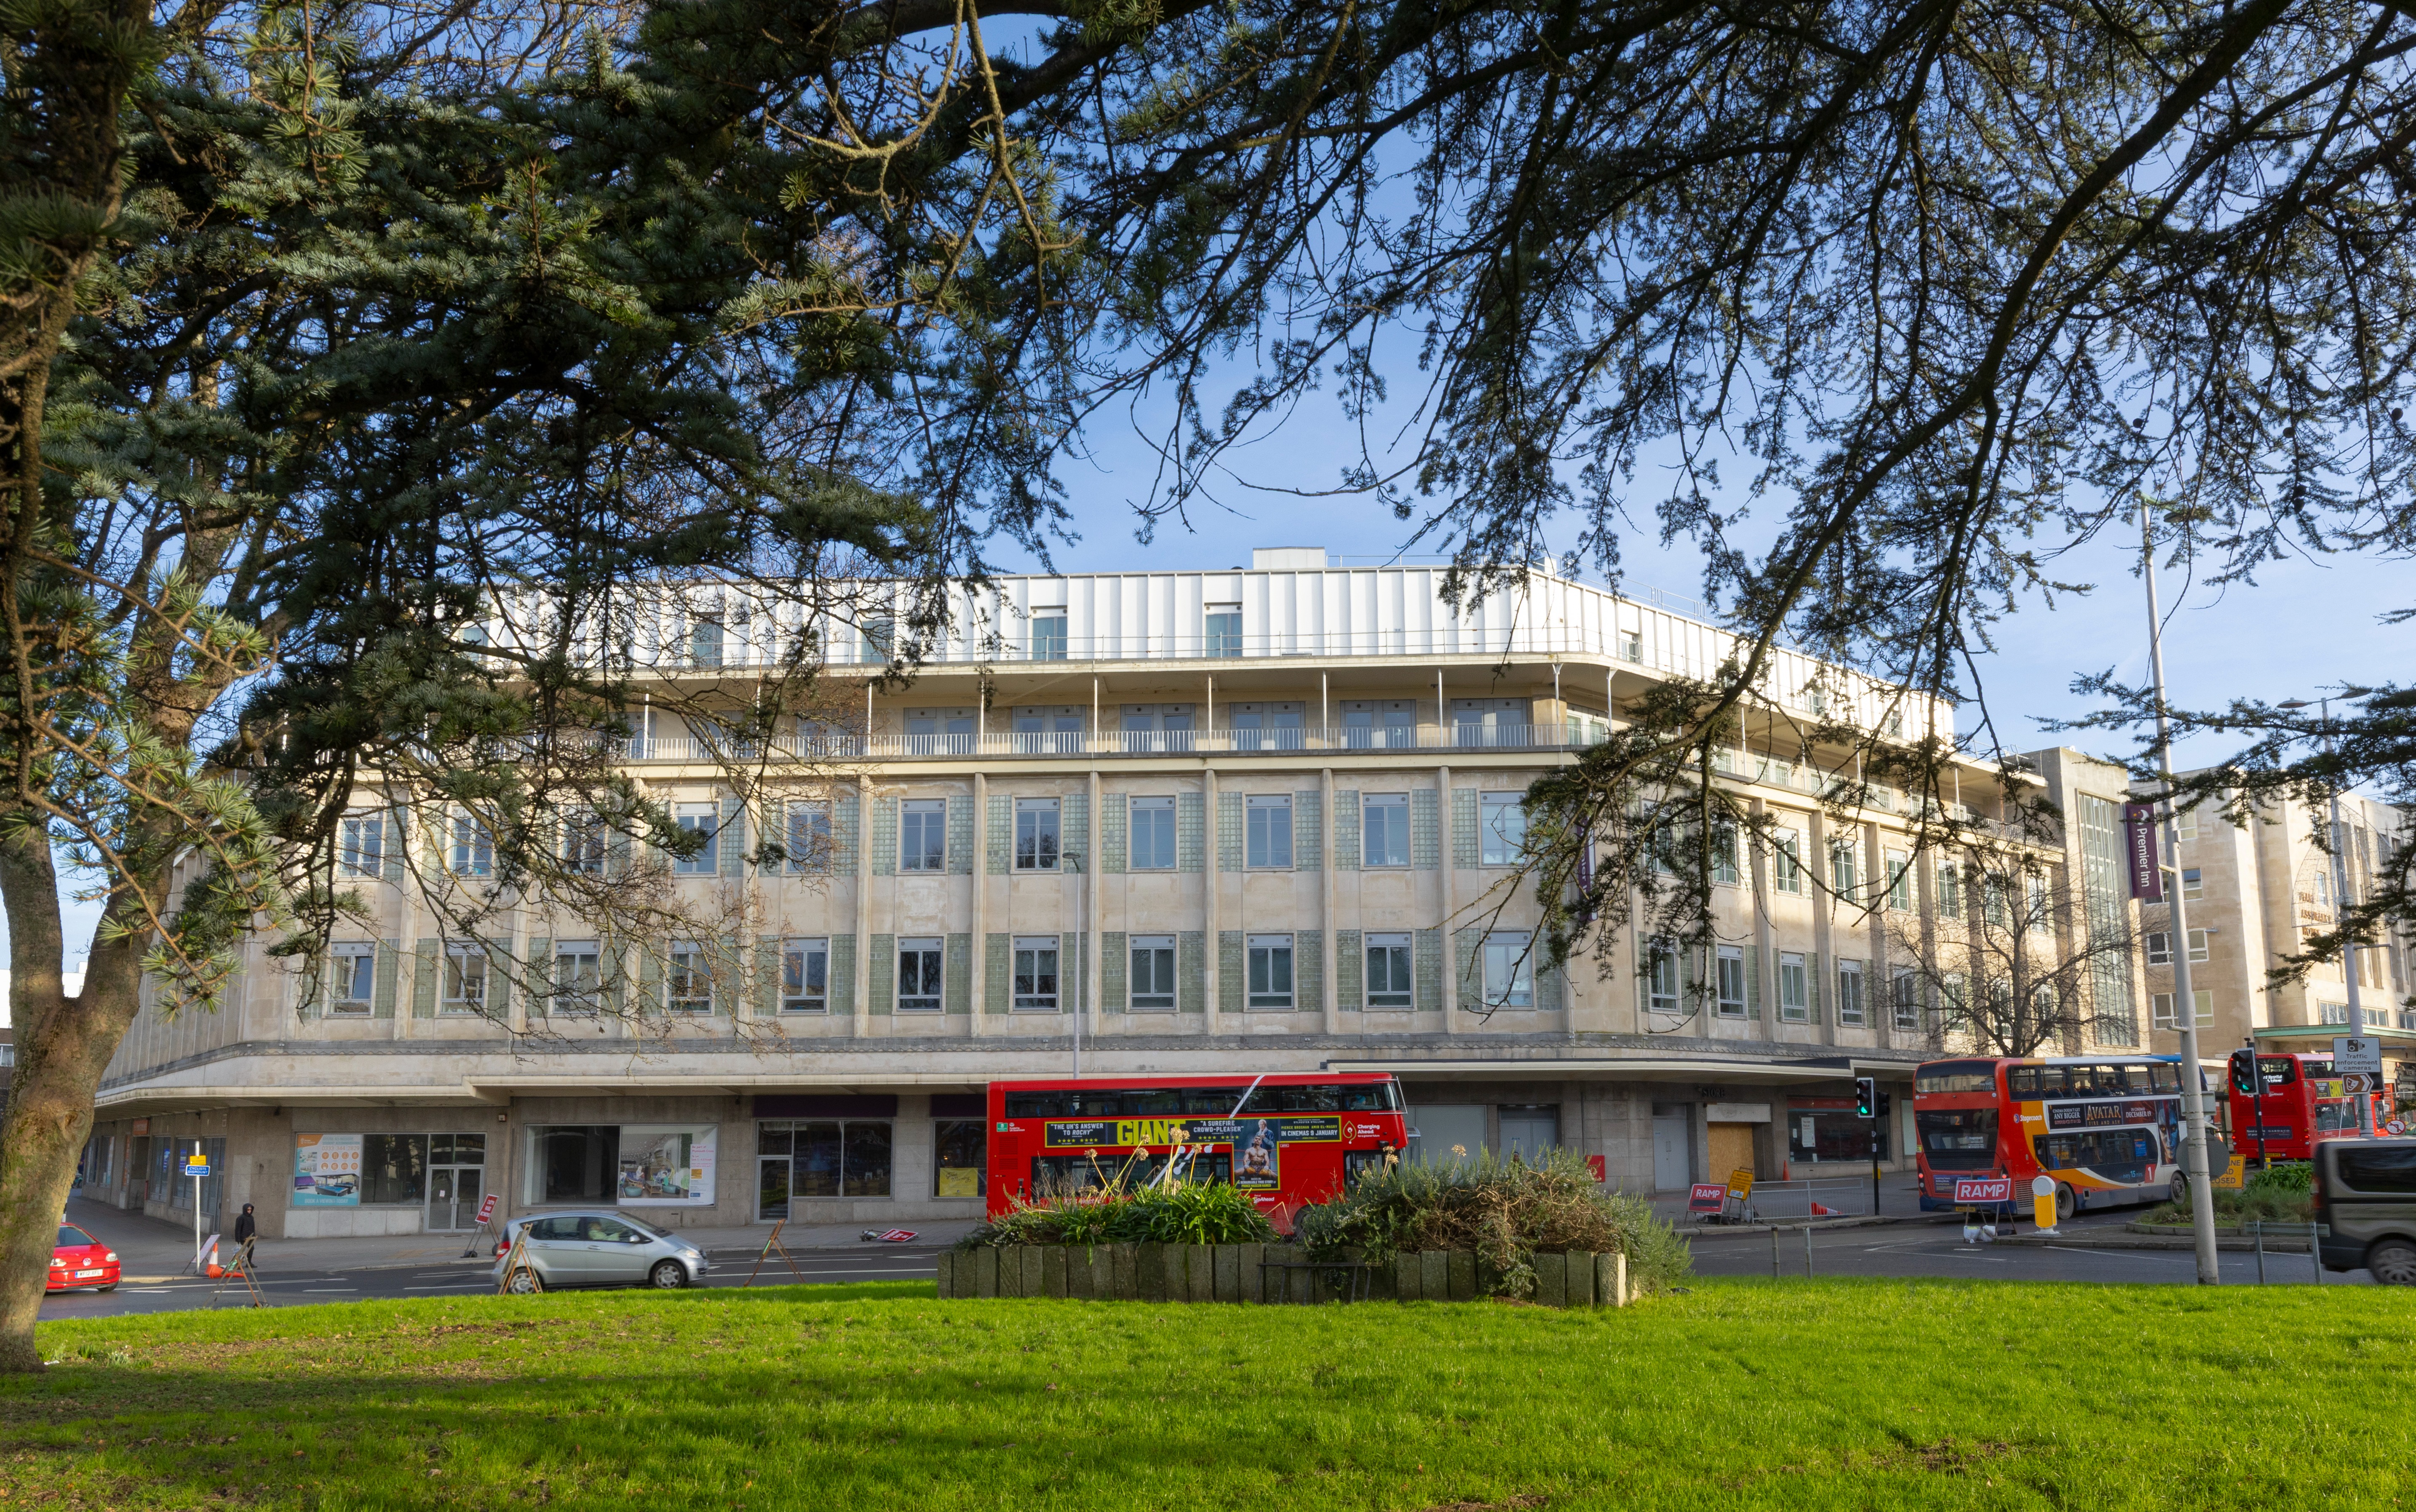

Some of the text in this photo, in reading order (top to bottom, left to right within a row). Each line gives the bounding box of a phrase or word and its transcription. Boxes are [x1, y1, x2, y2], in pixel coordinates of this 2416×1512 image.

[2137, 828, 2151, 887] Premier Inn
[1702, 1088, 1725, 1098] STORE
[2020, 1115, 2042, 1123] Stagecoach
[2087, 1105, 2122, 1120] AVATAR
[1954, 1116, 1960, 1125] 2
[1117, 1120, 1186, 1145] GIANT
[2148, 1167, 2152, 1180] 1
[1696, 1189, 1720, 1198] RAMP
[1961, 1184, 2005, 1197] RAMP
